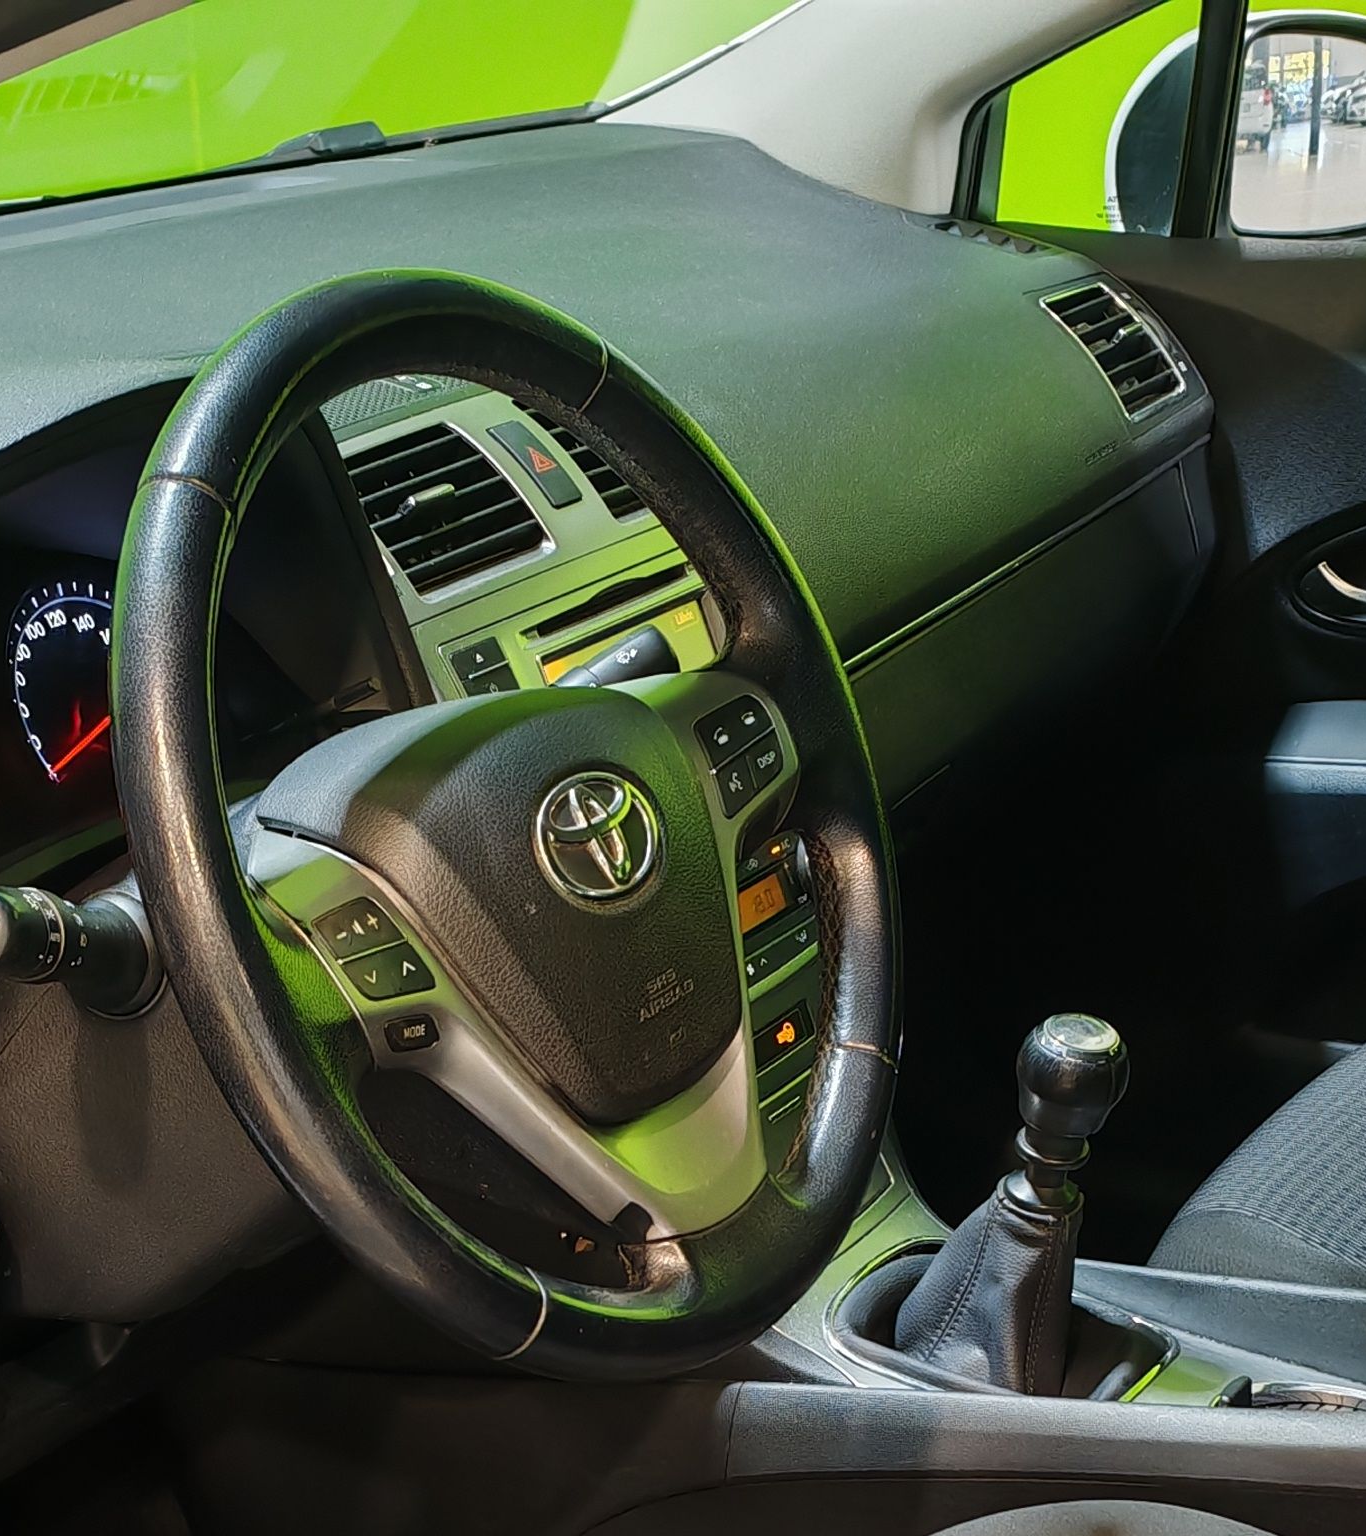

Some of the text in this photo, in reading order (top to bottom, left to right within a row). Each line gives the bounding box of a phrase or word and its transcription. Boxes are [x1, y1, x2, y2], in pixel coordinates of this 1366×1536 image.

[43, 608, 67, 629] 120
[71, 612, 96, 634] 140
[24, 621, 46, 642] 100
[756, 750, 776, 769] DISP
[402, 1023, 427, 1040] MODE
